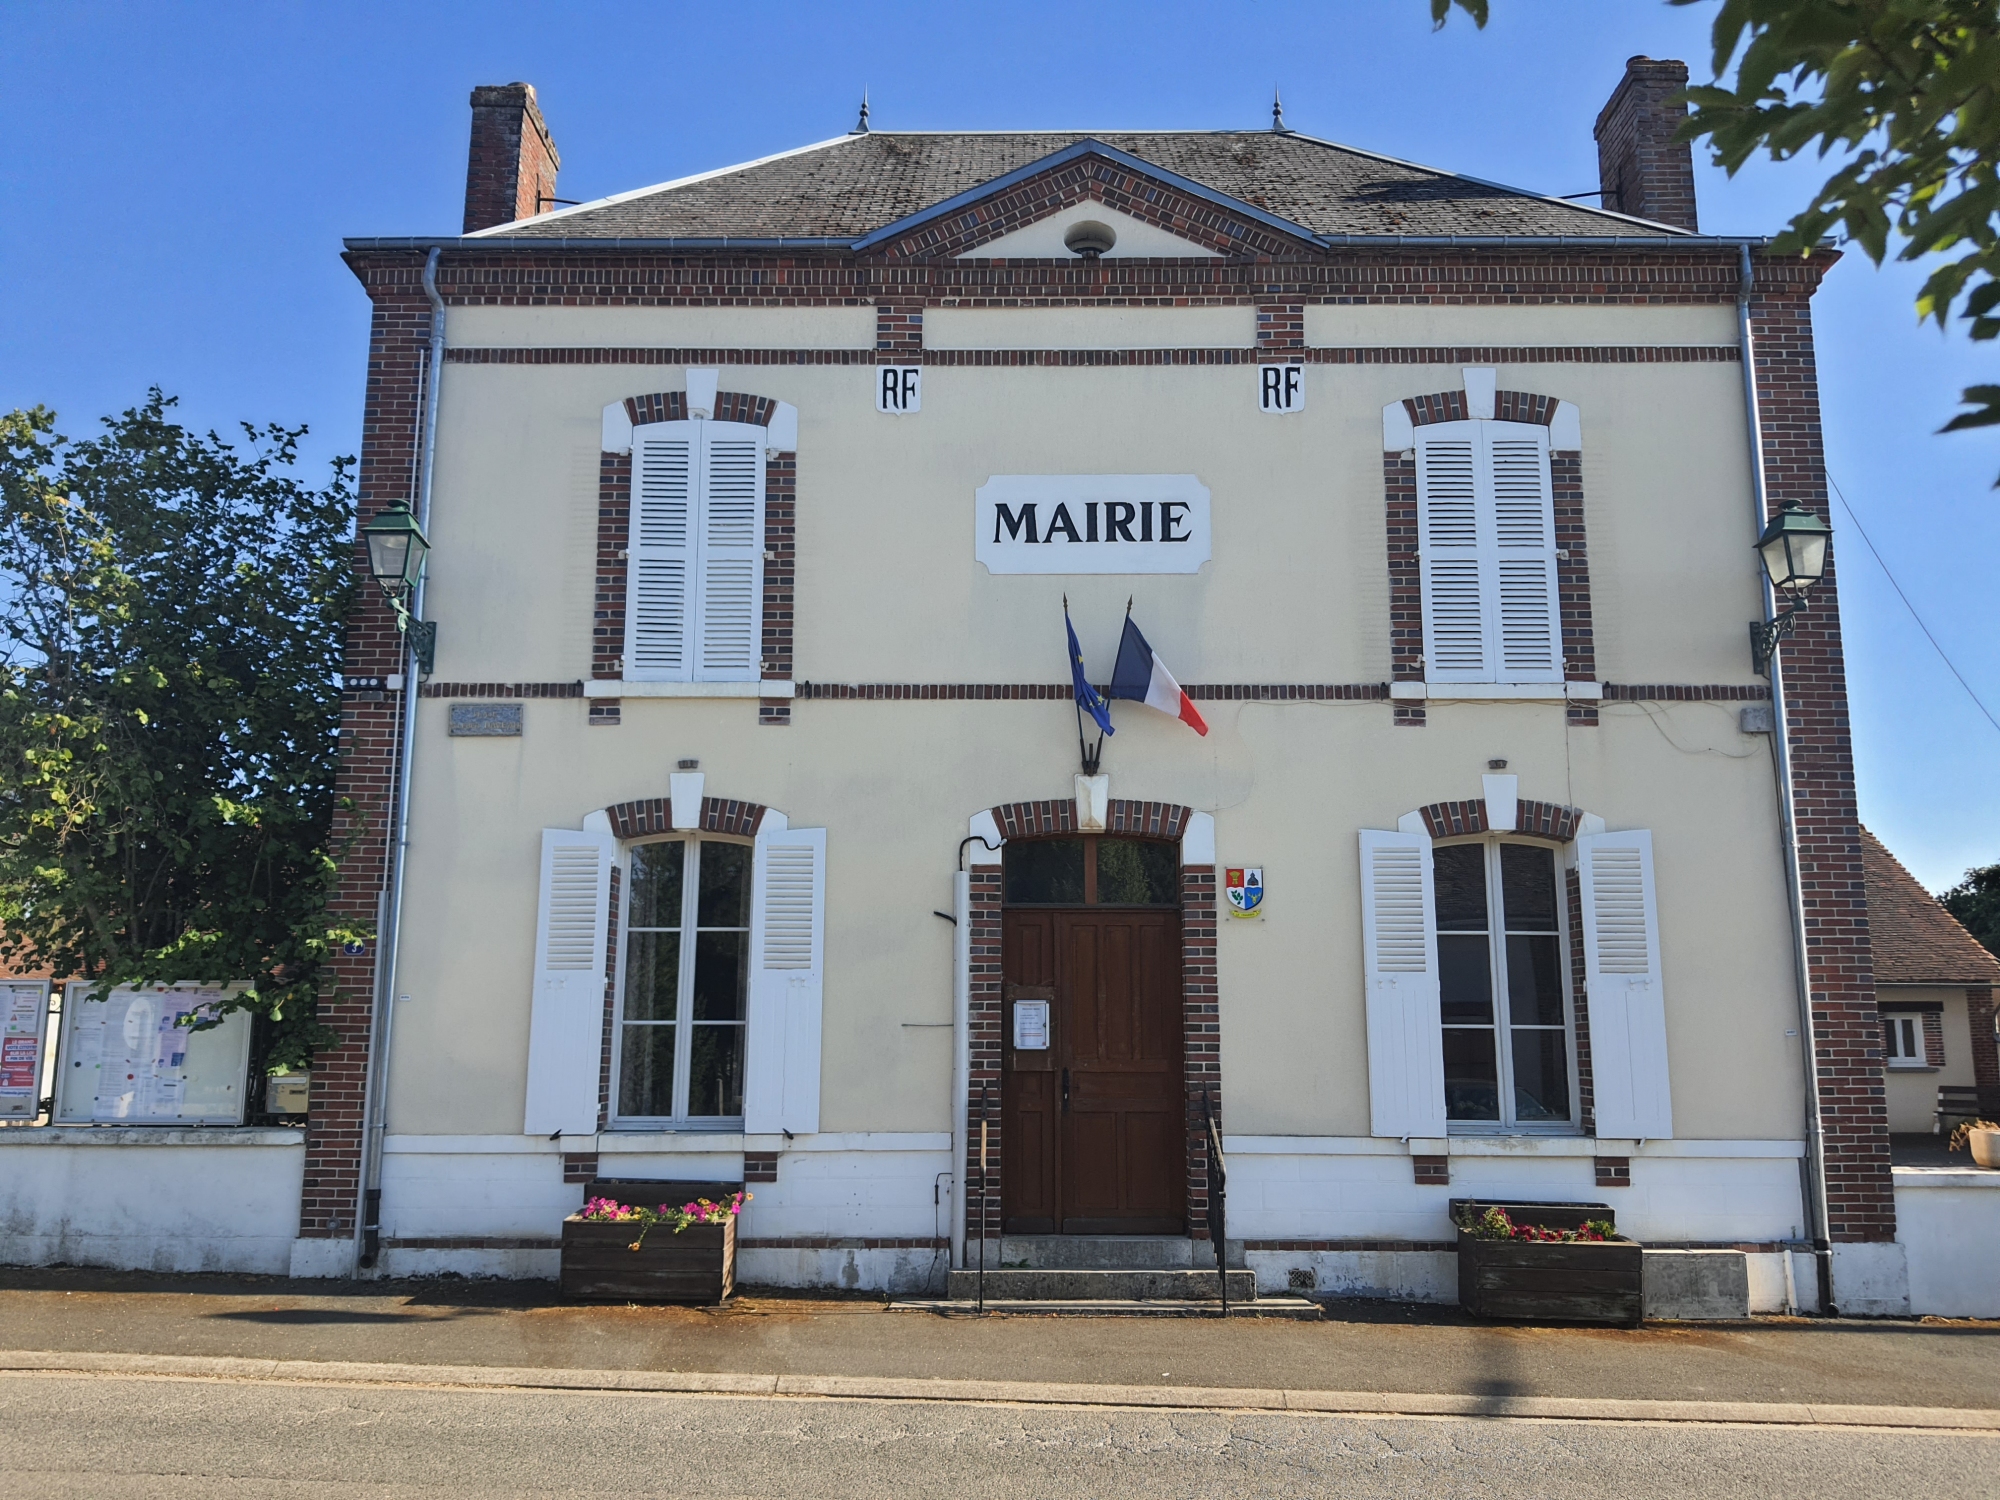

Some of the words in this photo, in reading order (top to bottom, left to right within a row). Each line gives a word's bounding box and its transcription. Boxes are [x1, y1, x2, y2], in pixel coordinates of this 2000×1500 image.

[882, 368, 919, 410] RF
[1262, 366, 1301, 409] RF
[993, 501, 1192, 544] MAIRIE
